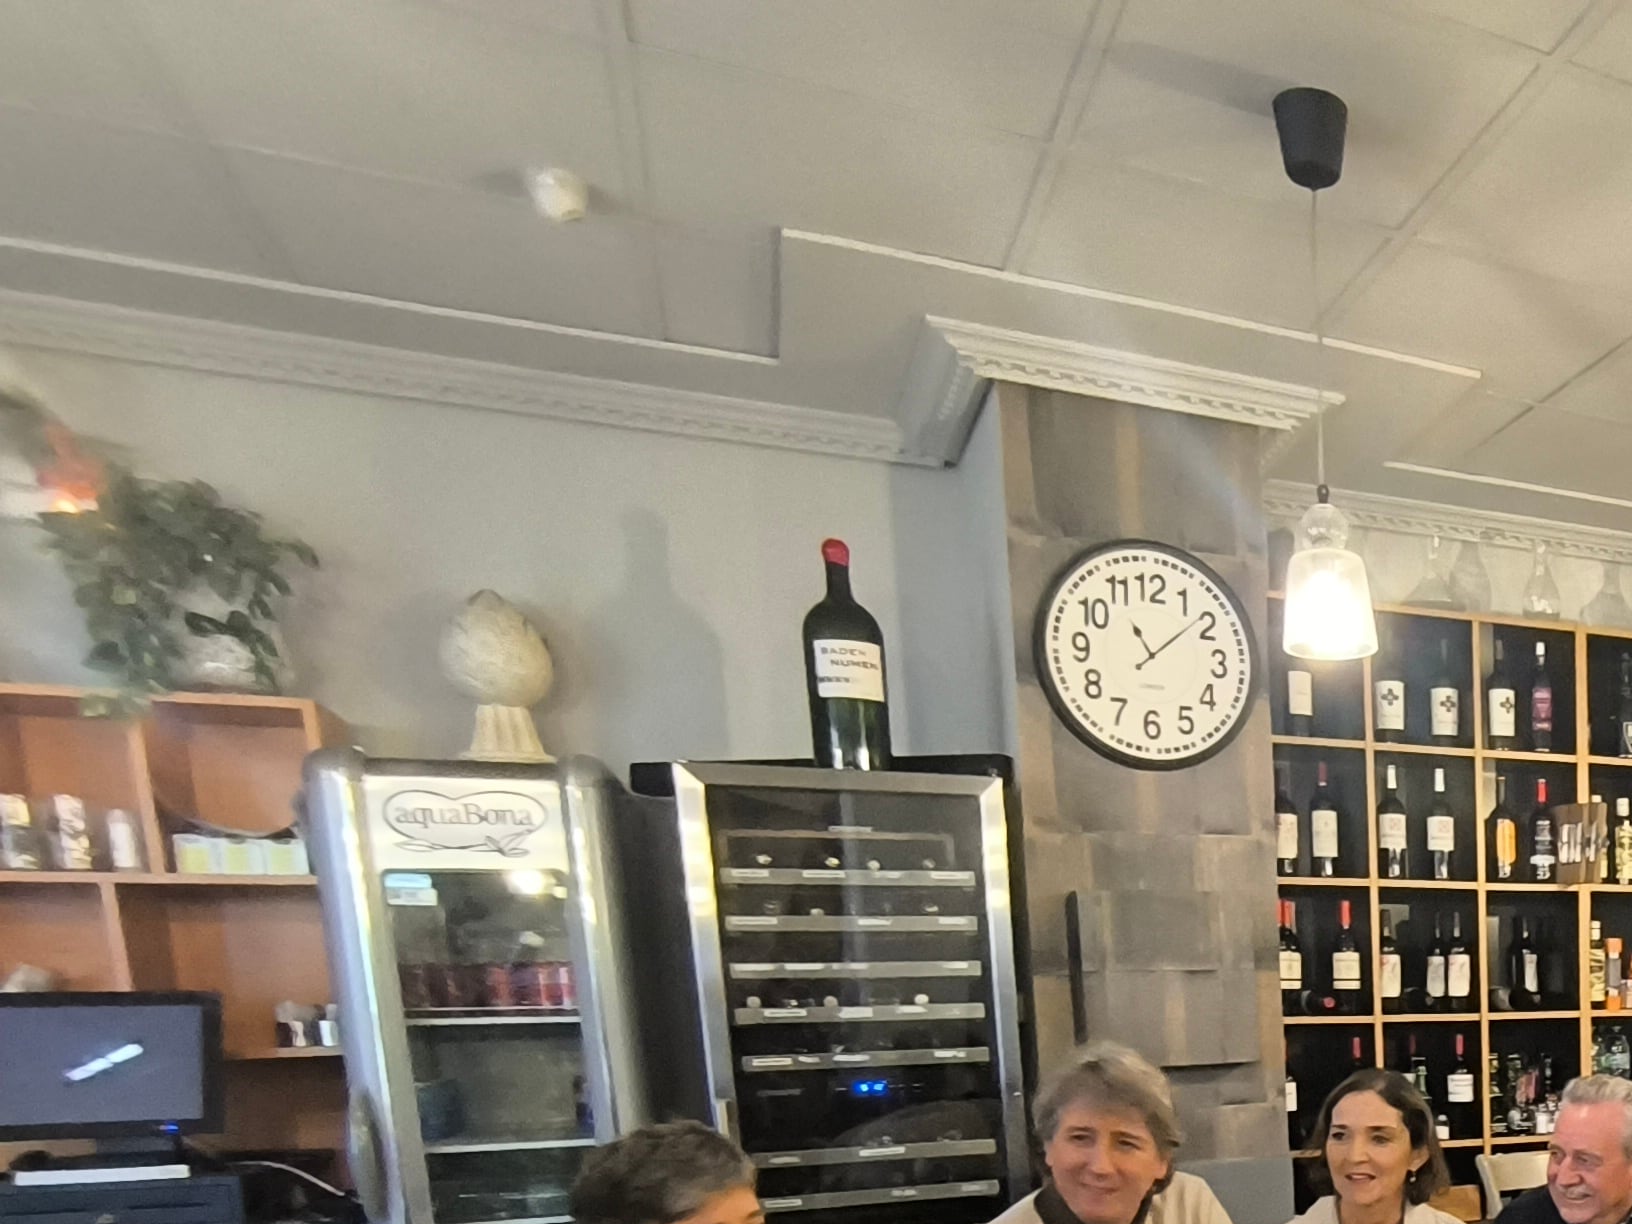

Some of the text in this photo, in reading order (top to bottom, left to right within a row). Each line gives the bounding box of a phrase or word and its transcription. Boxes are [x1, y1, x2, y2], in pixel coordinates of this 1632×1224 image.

[1105, 574, 1129, 606] 11
[1134, 572, 1167, 605] 12
[1176, 587, 1188, 617] 1
[1078, 597, 1109, 629] 10
[1199, 611, 1217, 641] 2
[1071, 631, 1090, 663] 9
[1210, 649, 1227, 679] 3
[1084, 668, 1102, 699] 8
[1199, 684, 1216, 712] 4
[1109, 697, 1128, 726] 7
[1143, 710, 1161, 740] 6
[1177, 706, 1194, 735] 5
[394, 803, 535, 829] aquaBona
